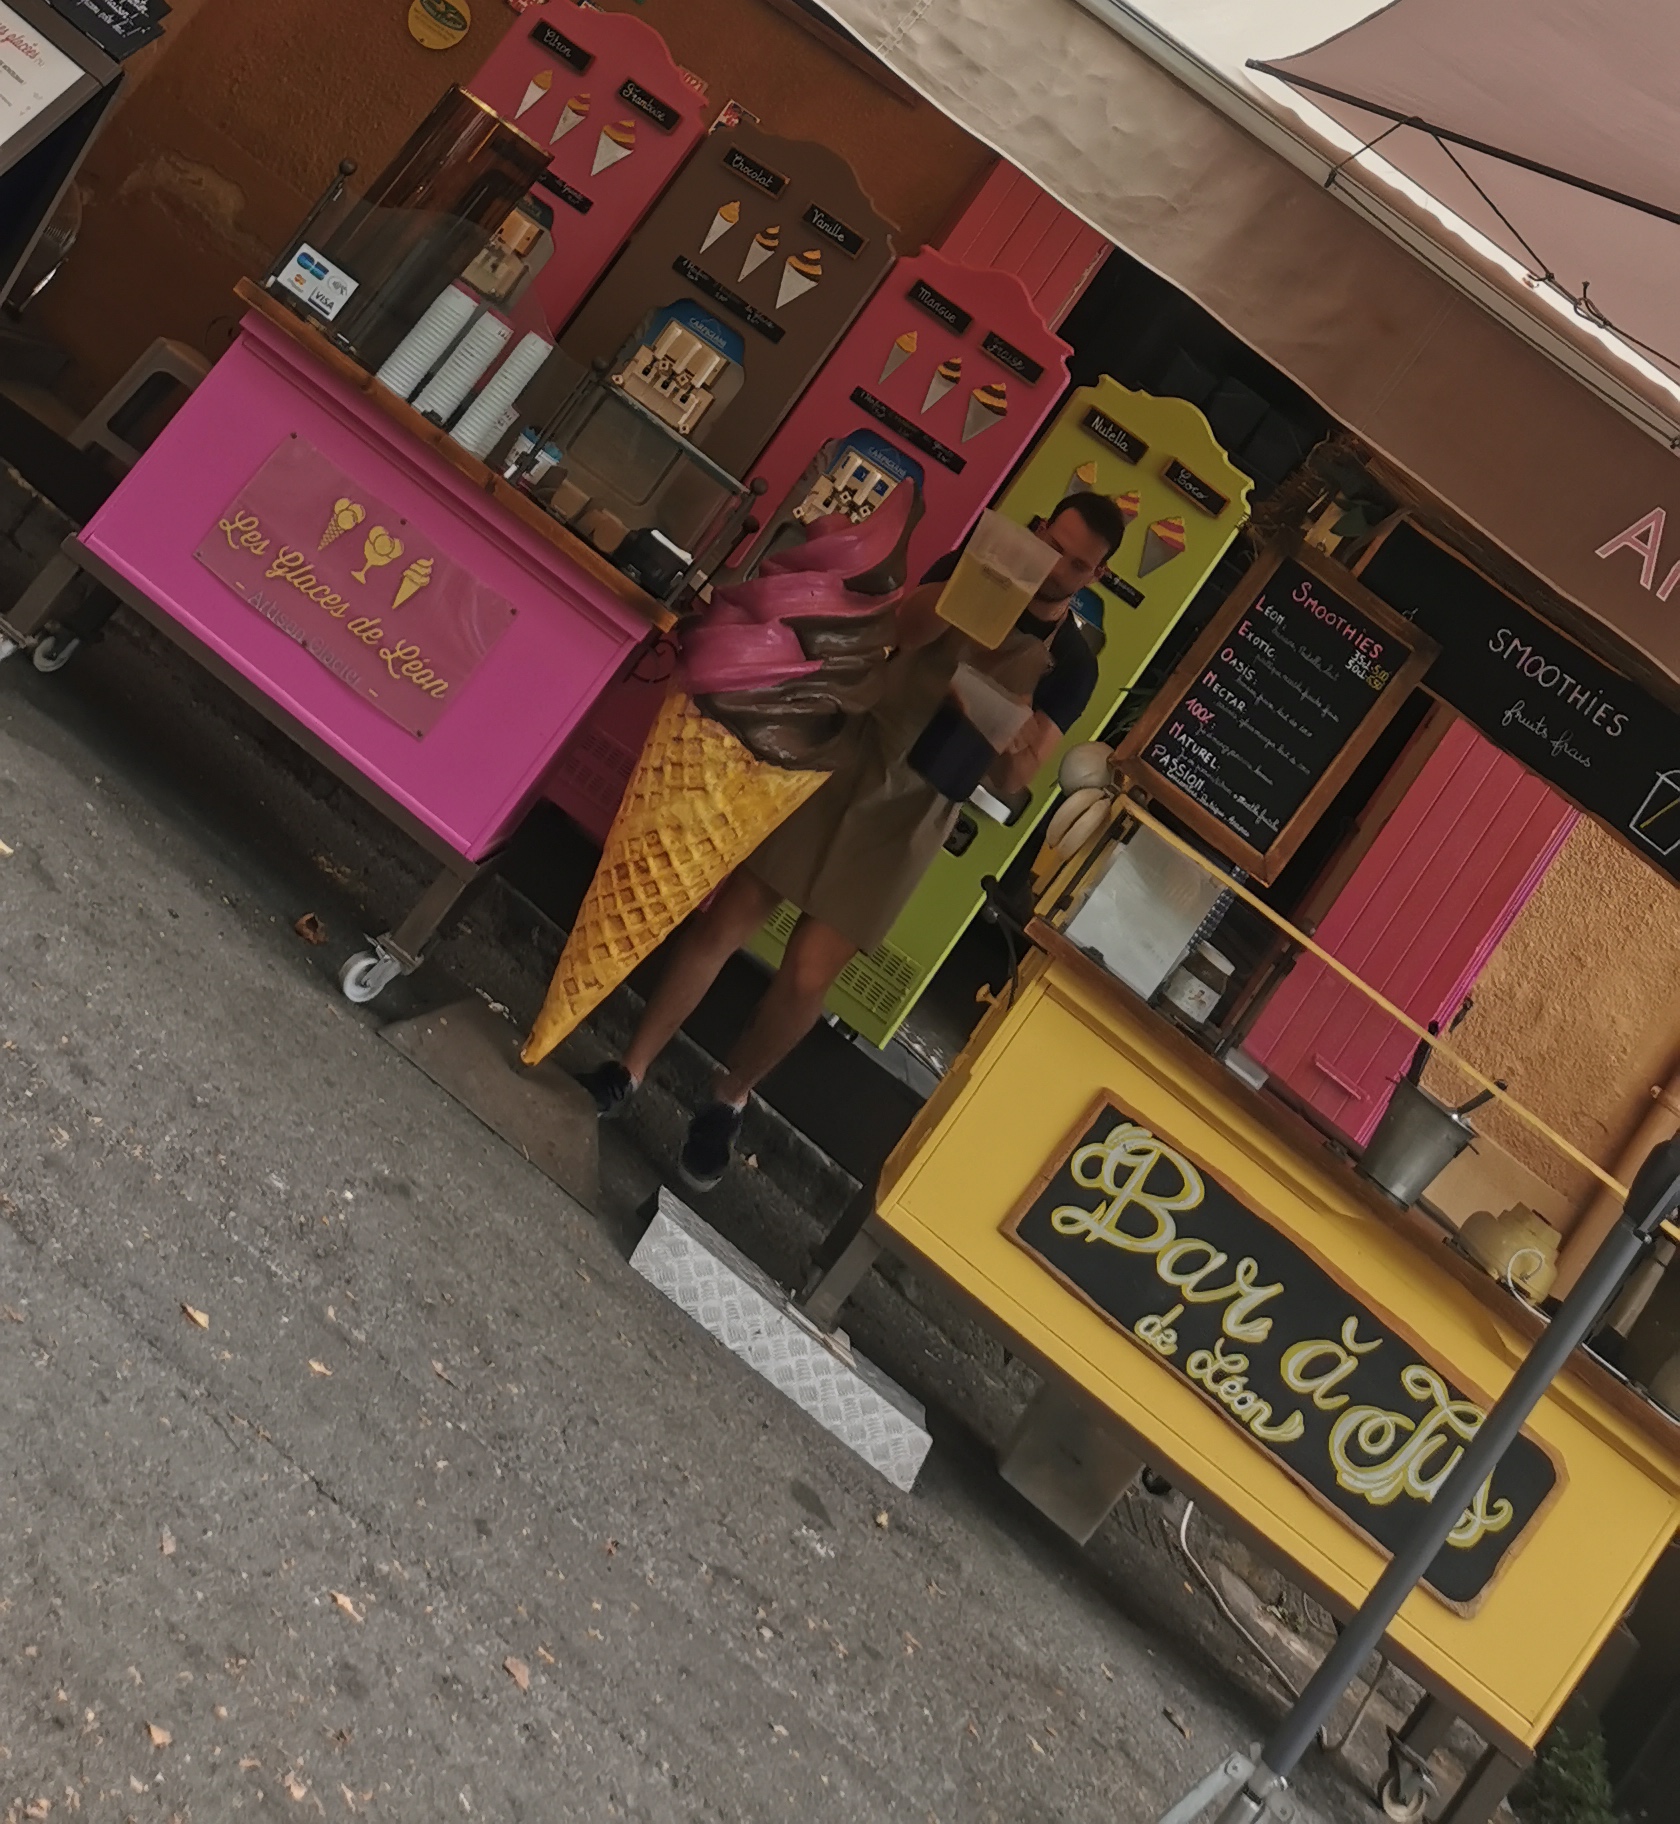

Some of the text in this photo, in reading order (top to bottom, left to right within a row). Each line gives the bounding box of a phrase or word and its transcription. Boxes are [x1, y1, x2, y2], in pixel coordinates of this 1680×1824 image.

[543, 28, 572, 57] Citron
[731, 154, 773, 189] Chocolat
[812, 209, 847, 241] Vanille
[315, 291, 334, 309] VISA
[687, 317, 727, 348] CARPIGIANI
[985, 341, 1025, 370] Fraise
[1091, 415, 1129, 452] Nutella
[867, 446, 906, 478] CARPIGIANI
[1174, 469, 1209, 499] Coco
[219, 510, 448, 697] Les Glaces de Léon
[247, 589, 362, 687] Artisan Glacier
[1501, 699, 1590, 767] fruits frais
[1052, 1123, 1284, 1343] Bar
[1134, 1304, 1305, 1442] de Léon
